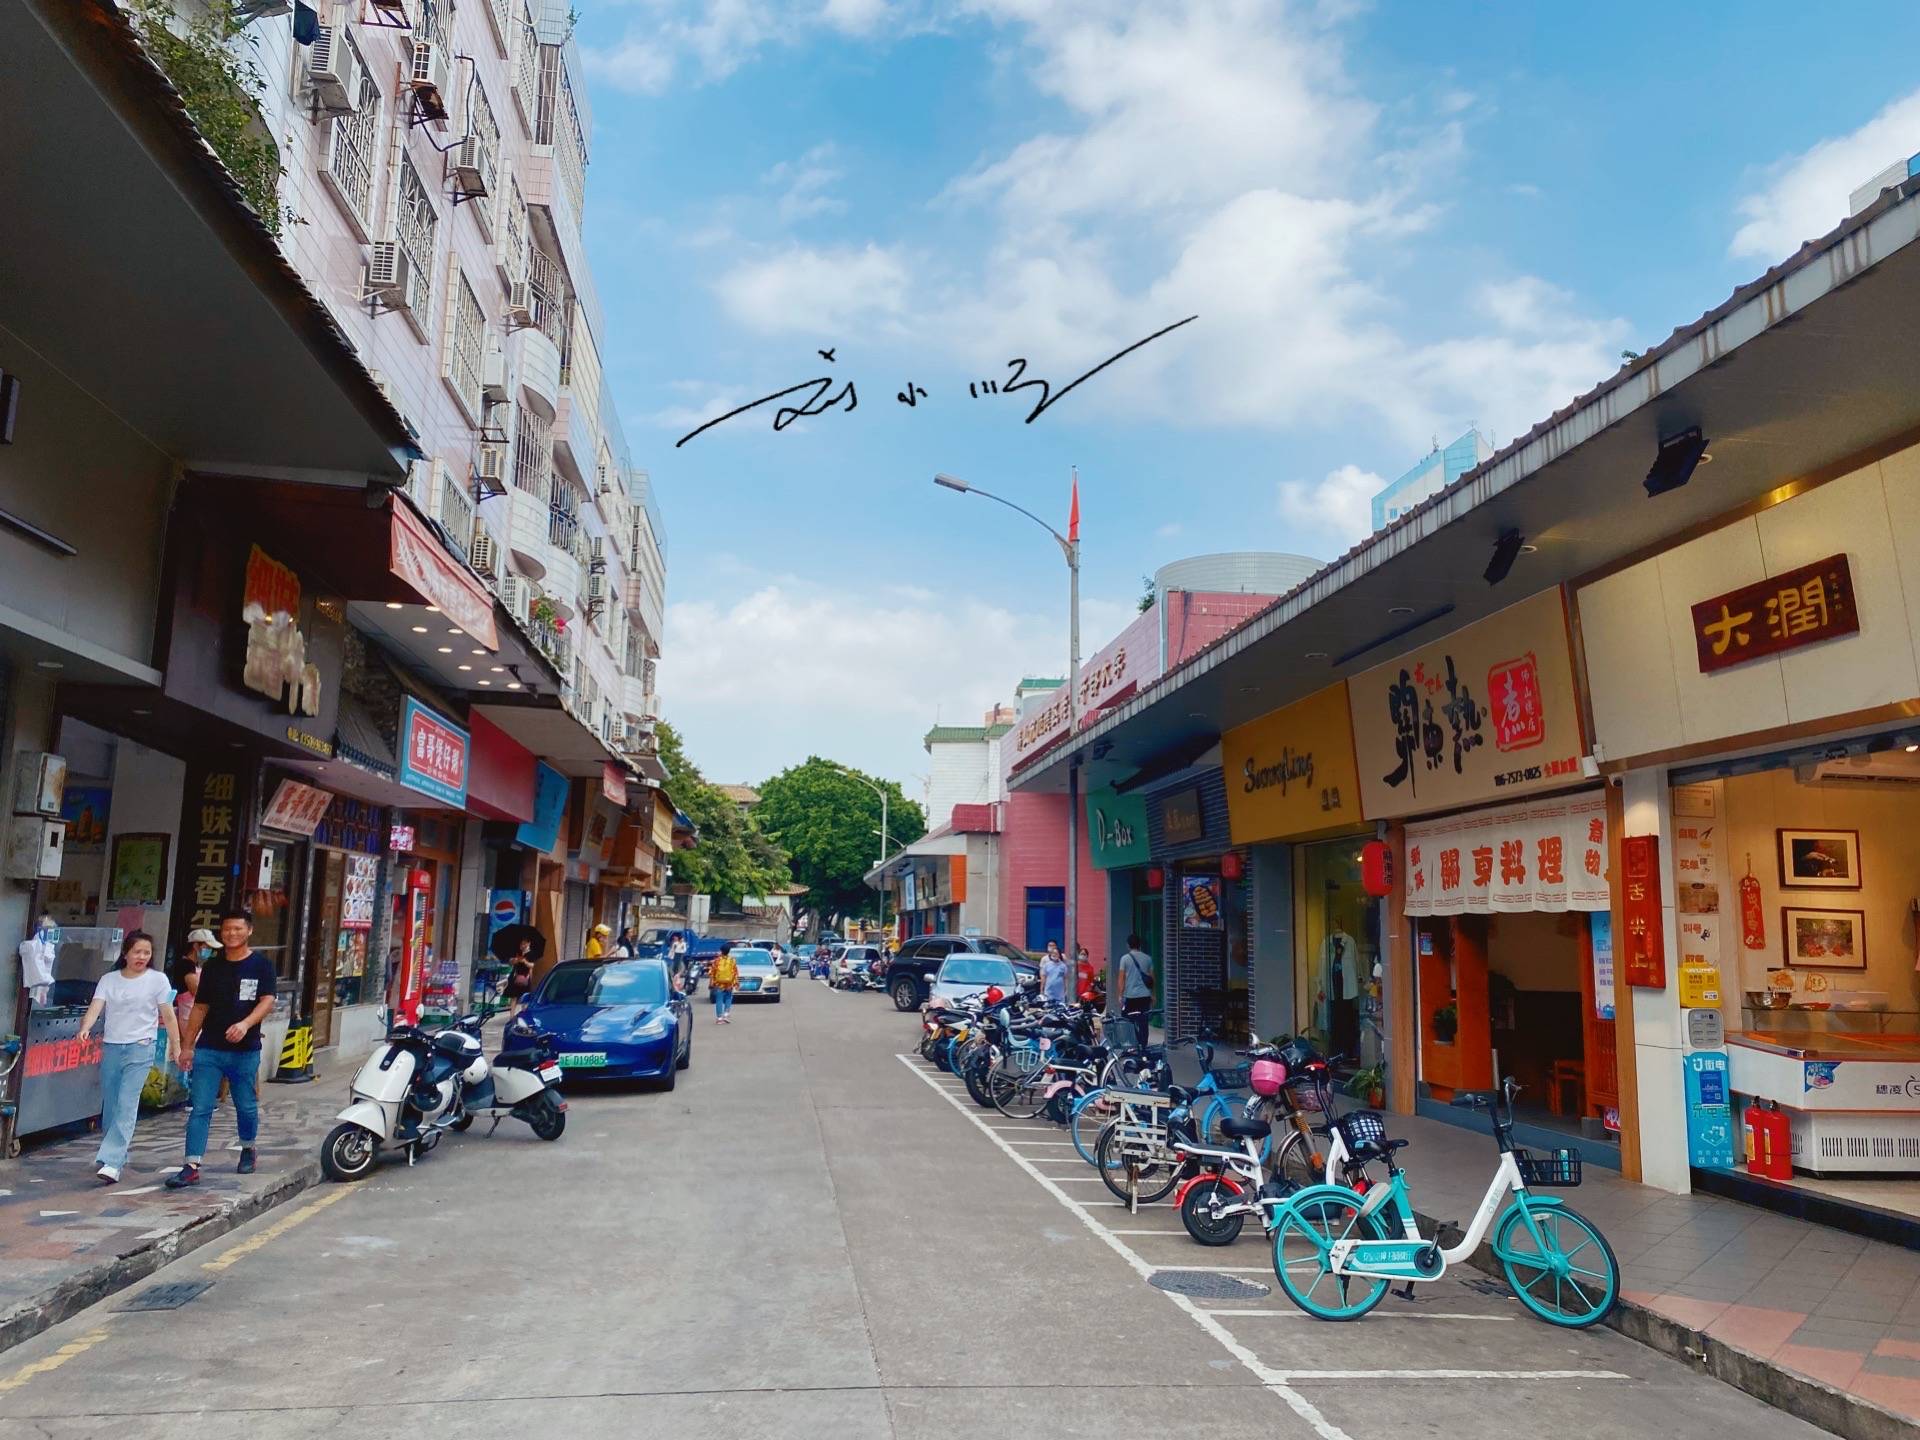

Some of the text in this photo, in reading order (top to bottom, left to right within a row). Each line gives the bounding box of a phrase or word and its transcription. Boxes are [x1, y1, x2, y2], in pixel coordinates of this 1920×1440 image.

[1703, 575, 1828, 655] 大潤
[1440, 836, 1564, 892] 關東料理
[1628, 882, 1648, 969] 舌尖上
